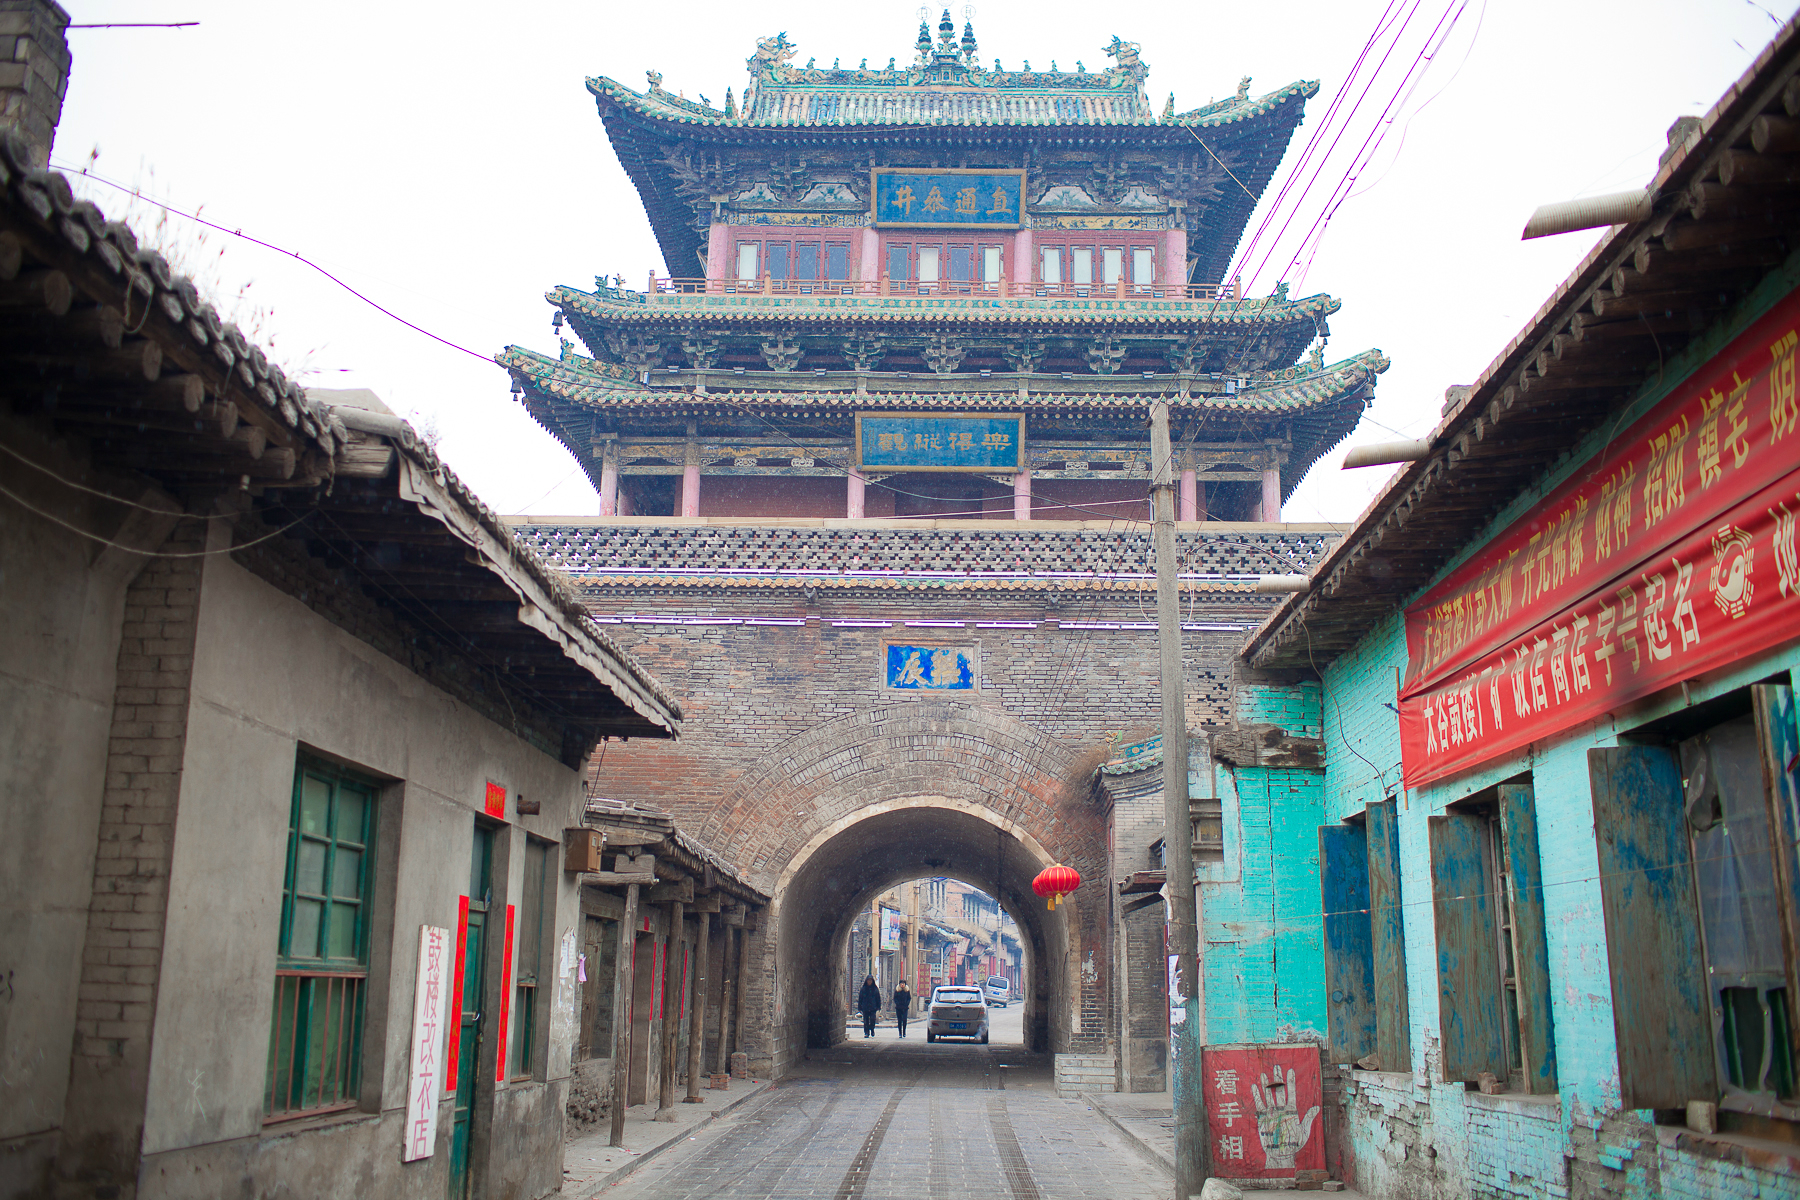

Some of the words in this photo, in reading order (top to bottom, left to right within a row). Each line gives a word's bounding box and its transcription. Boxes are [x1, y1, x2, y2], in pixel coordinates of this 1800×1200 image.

[410, 926, 443, 1160] 鼓楼改衣店
[1214, 1069, 1244, 1160] 看手相
